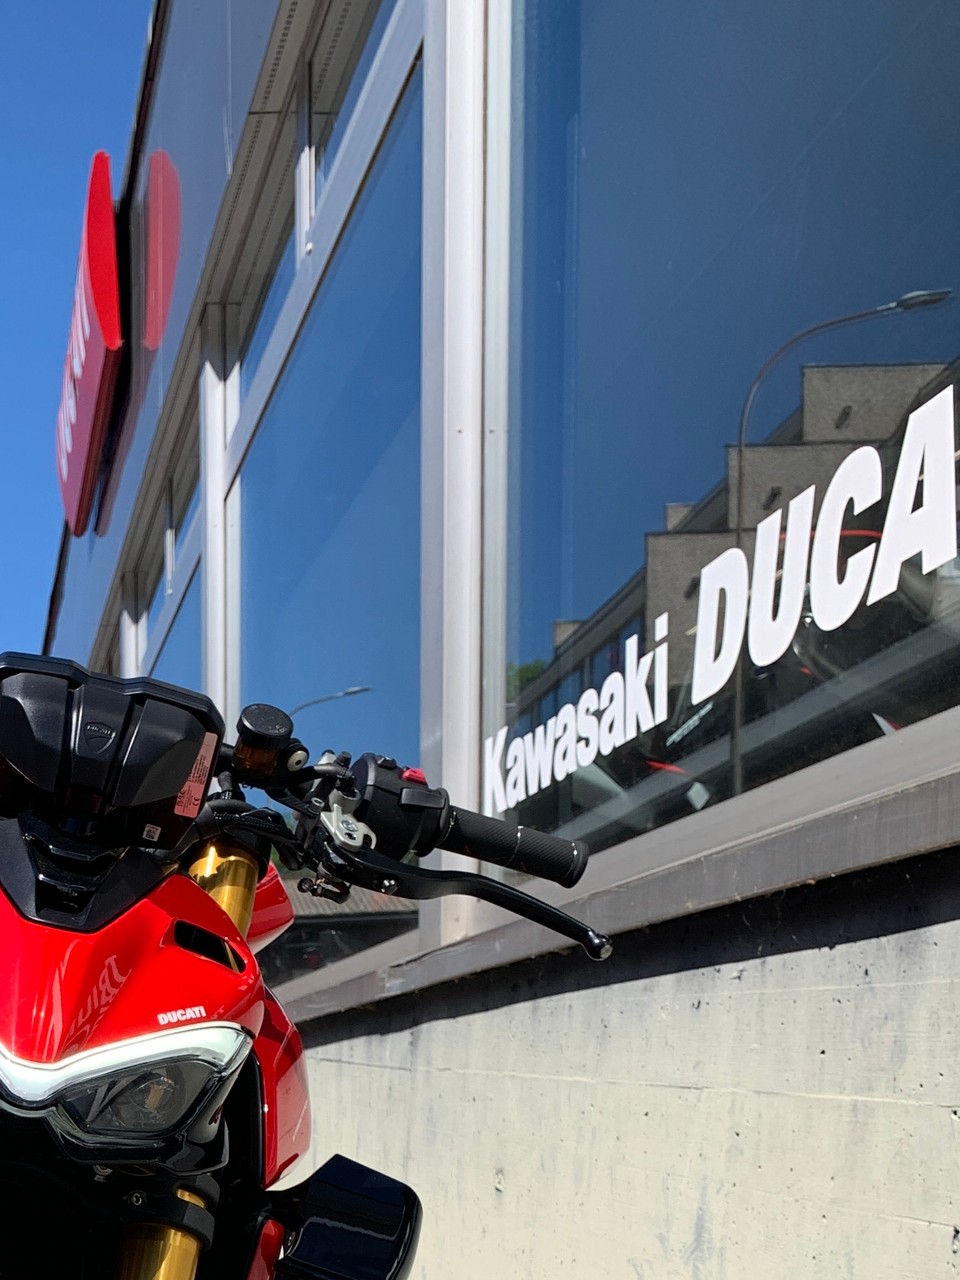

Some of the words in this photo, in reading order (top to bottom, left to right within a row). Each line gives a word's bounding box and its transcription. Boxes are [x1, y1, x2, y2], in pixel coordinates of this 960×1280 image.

[483, 612, 669, 817] Kawasaki
[691, 384, 958, 705] DUCA
[157, 1005, 207, 1025] DUCATI
